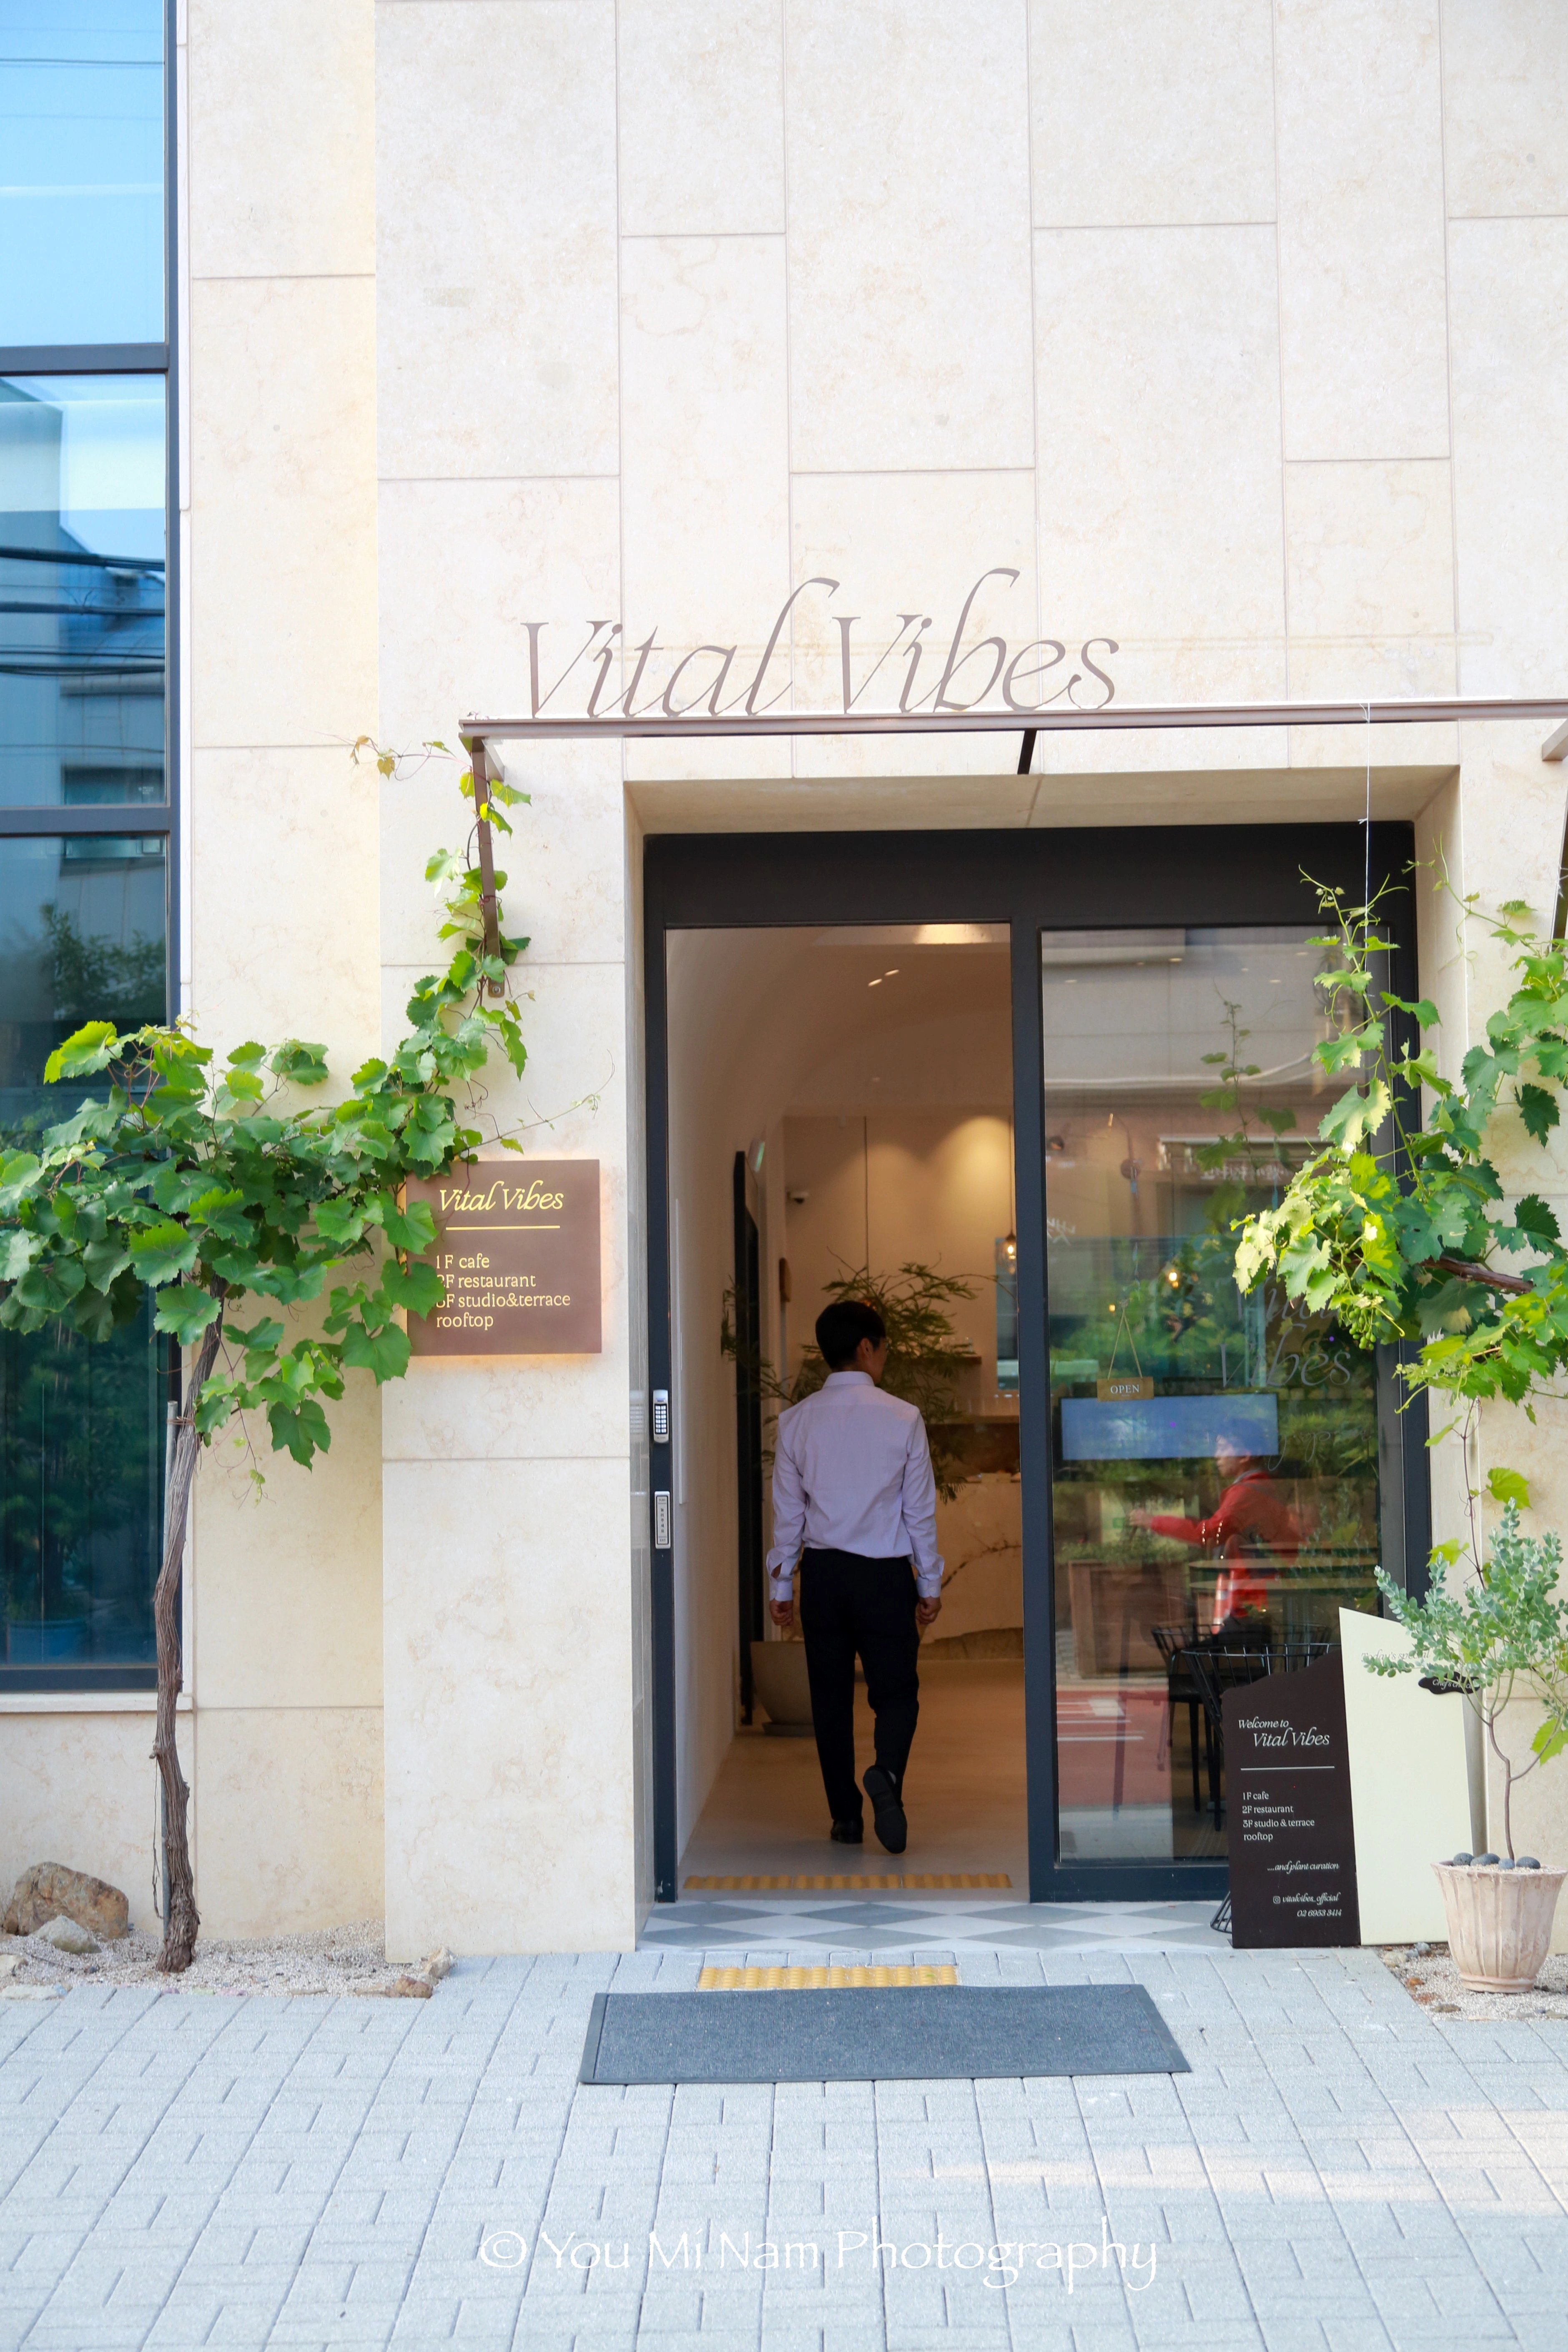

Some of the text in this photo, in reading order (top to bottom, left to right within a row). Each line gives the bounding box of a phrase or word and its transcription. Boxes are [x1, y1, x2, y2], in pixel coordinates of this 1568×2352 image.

[519, 567, 1120, 718] Vital Vibes
[439, 1180, 564, 1211] Vital Vibes
[459, 1253, 490, 1268] cafe
[458, 1274, 537, 1288] restaurant
[436, 1312, 494, 1330] rooftop
[1220, 1323, 1351, 1388] Vibes
[1110, 1384, 1139, 1394] OPEN
[1238, 1716, 1289, 1729] Welcome to
[1254, 1727, 1330, 1747] Vital Vibes
[1243, 1791, 1269, 1800] 1F cafe
[1242, 1805, 1252, 1814] 2F
[1254, 1818, 1279, 1827] studio
[1280, 1819, 1287, 1827] &
[1244, 1832, 1273, 1842] rooftop
[1286, 1860, 1310, 1875] plant
